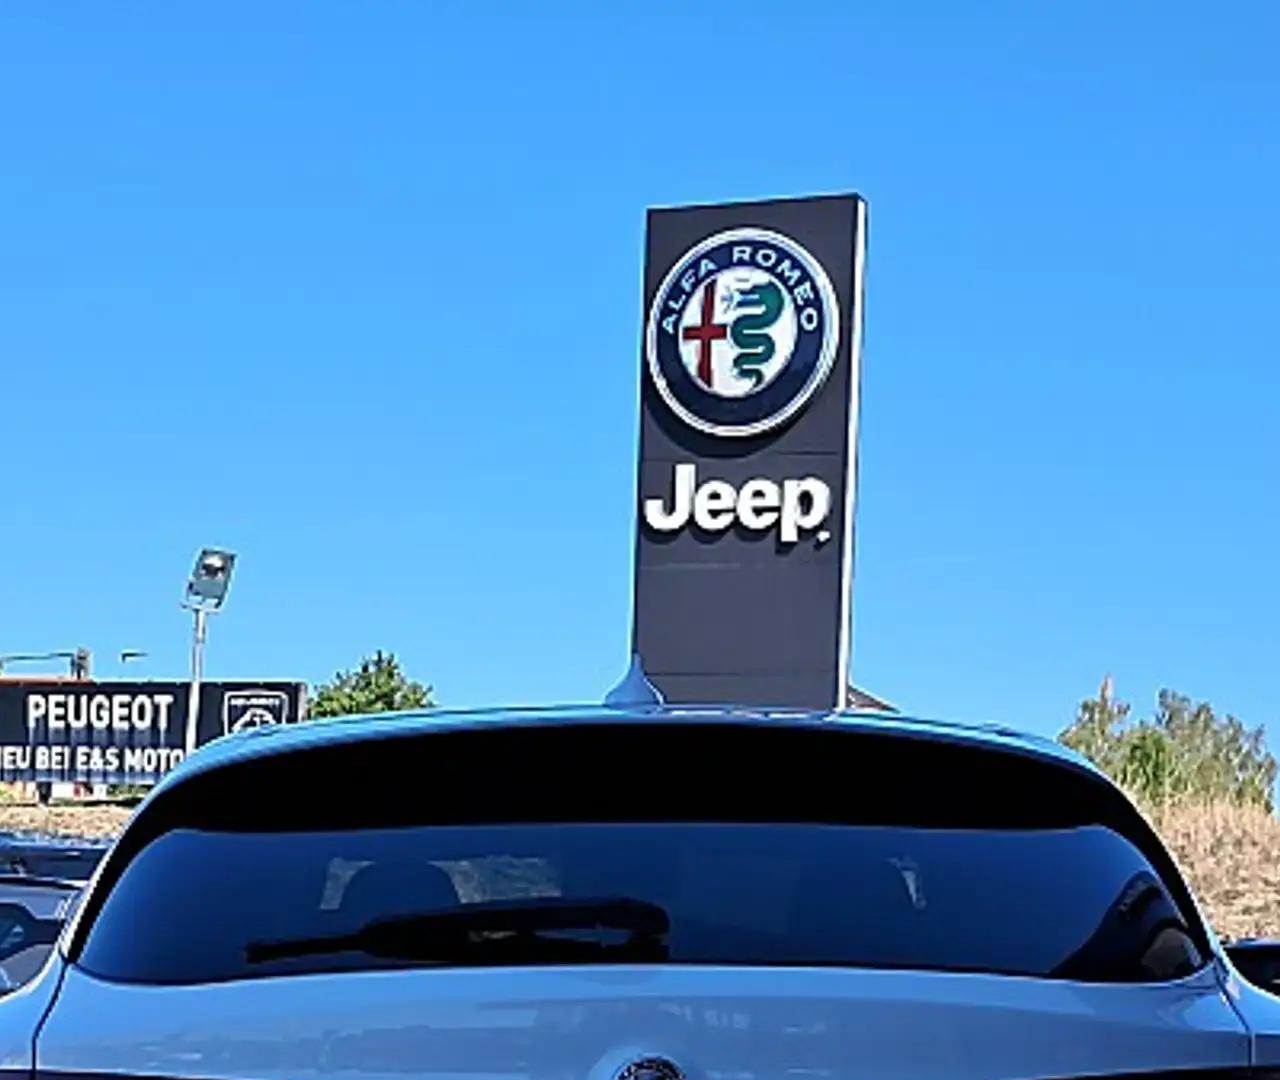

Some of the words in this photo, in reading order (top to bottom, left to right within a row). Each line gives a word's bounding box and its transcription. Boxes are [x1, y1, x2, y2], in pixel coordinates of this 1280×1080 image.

[662, 258, 717, 334] ALFA
[732, 246, 818, 331] ROMEO
[644, 463, 831, 542] Jeep
[28, 694, 174, 730] PEUGEOT
[35, 746, 69, 769] BEI
[76, 746, 119, 771] E&S
